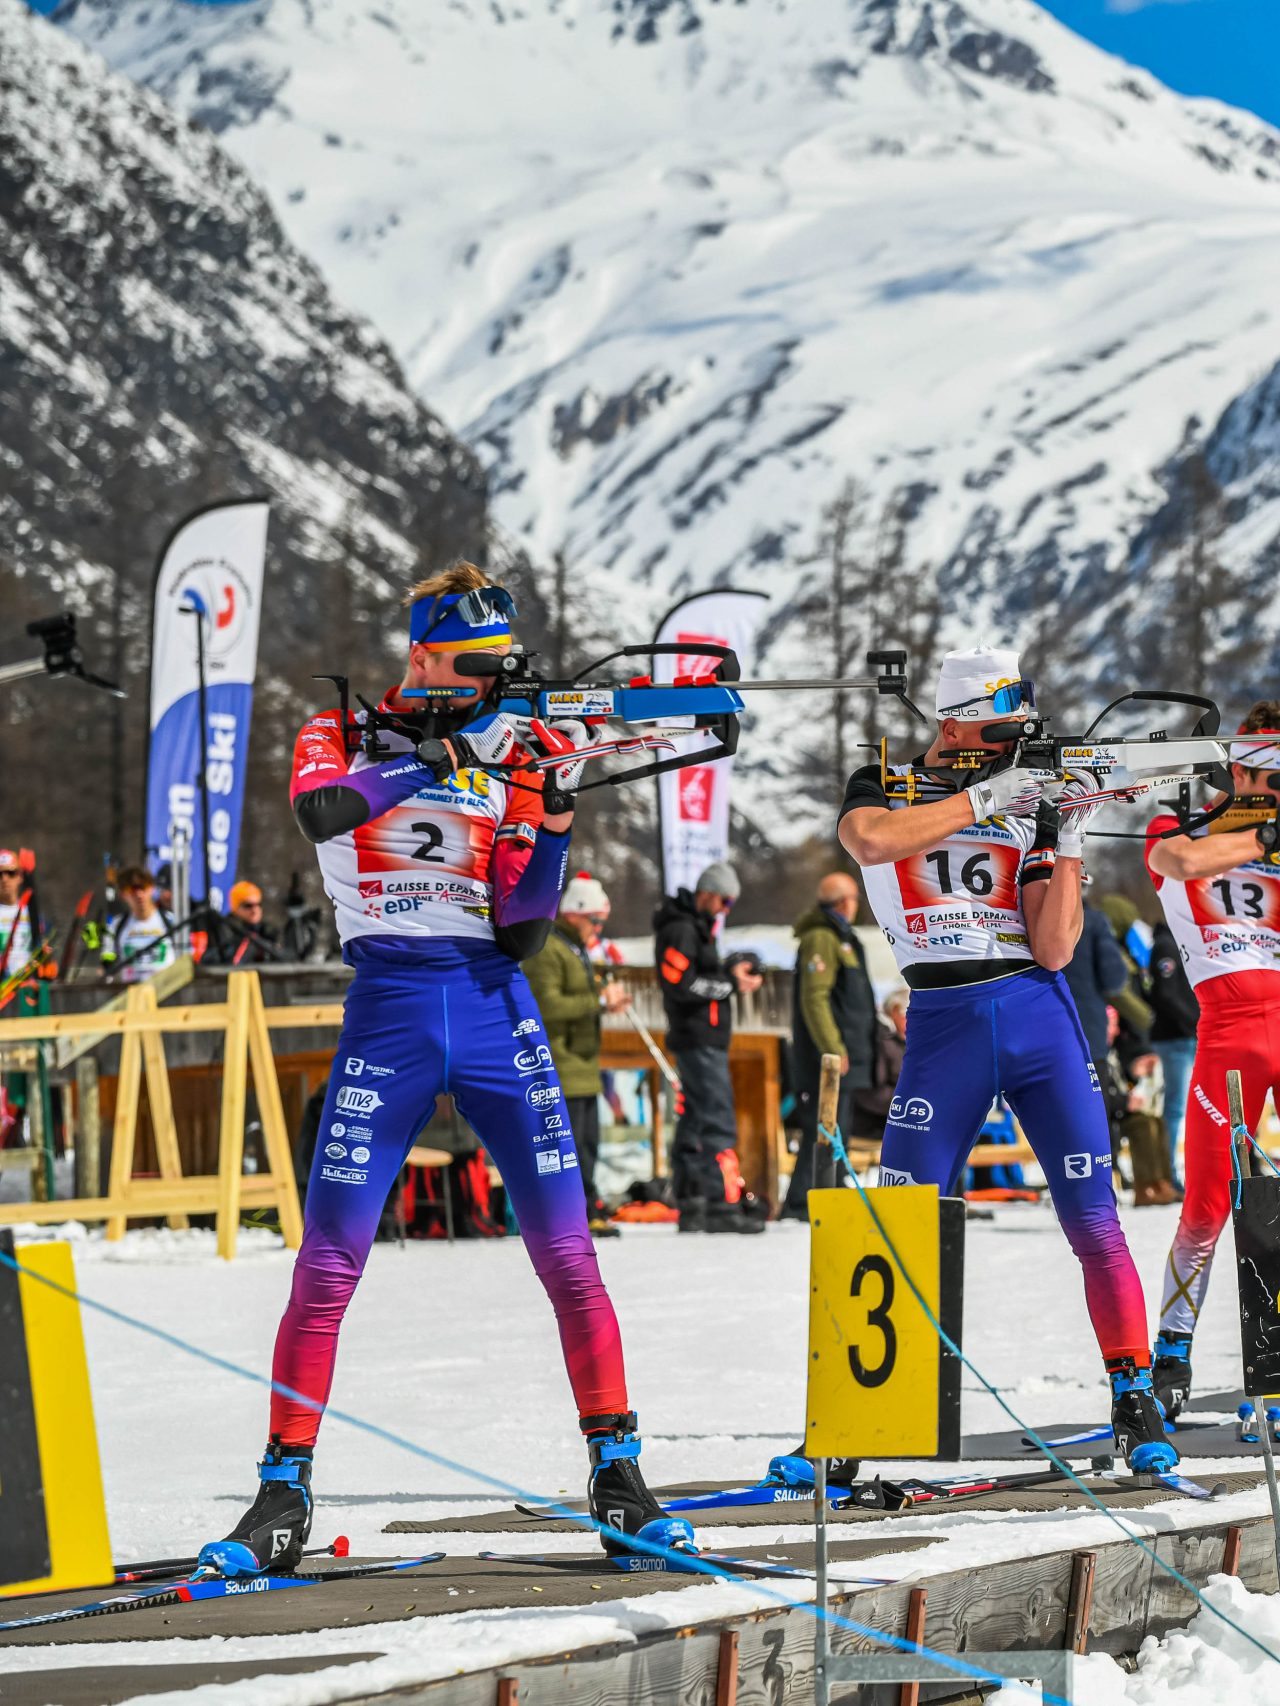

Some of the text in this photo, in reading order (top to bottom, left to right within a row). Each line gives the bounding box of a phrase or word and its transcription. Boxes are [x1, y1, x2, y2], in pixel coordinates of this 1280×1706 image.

[206, 713, 238, 796] Ski
[1062, 748, 1094, 759] SAMSE
[1153, 776, 1195, 787] LARSEN
[411, 822, 445, 863] 2
[925, 849, 994, 896] 16
[386, 882, 430, 892] CAISSE
[1212, 879, 1264, 919] 13
[929, 911, 967, 924] CAISSE
[519, 1055, 536, 1065] SKI
[910, 1106, 926, 1116] 25
[1192, 1083, 1229, 1127] TRIMTEX
[848, 1254, 897, 1389] 3
